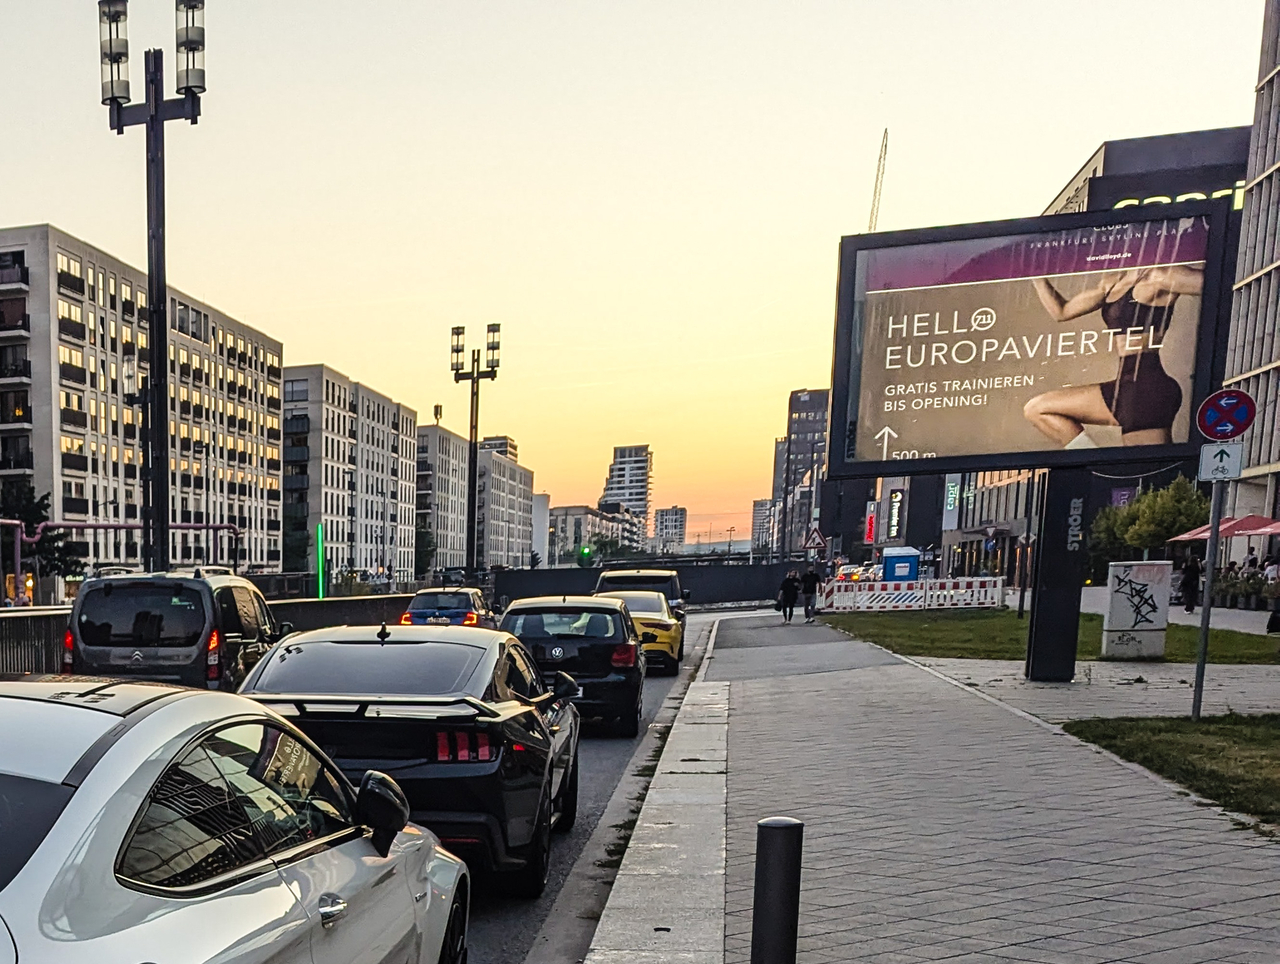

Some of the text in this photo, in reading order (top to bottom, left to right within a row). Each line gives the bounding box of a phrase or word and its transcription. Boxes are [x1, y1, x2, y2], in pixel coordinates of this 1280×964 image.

[885, 325, 1164, 369] EUROPAVIERTEL
[885, 374, 1035, 397] GRATIS TRAINIEREN
[883, 393, 988, 412] BIS OPENING!
[947, 482, 956, 510] capri
